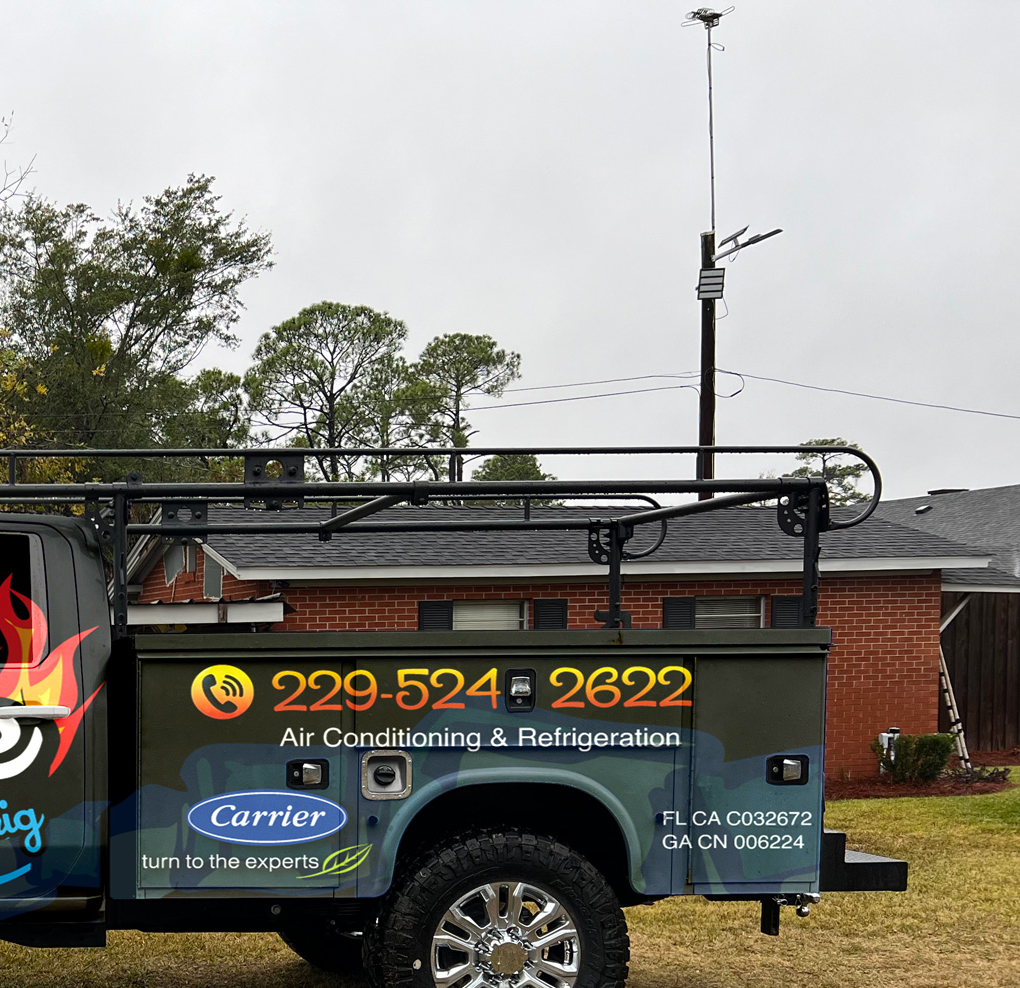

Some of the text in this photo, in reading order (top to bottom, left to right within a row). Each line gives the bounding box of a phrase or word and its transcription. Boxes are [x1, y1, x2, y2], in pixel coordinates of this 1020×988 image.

[271, 665, 692, 712] 229-524 2622
[279, 727, 682, 753] Air Conditioning & Refrigeration
[210, 803, 327, 829] Carrier
[662, 810, 813, 826] FL CA C032672
[662, 834, 805, 850] GA CN 006224
[141, 853, 320, 874] turn to the experts
